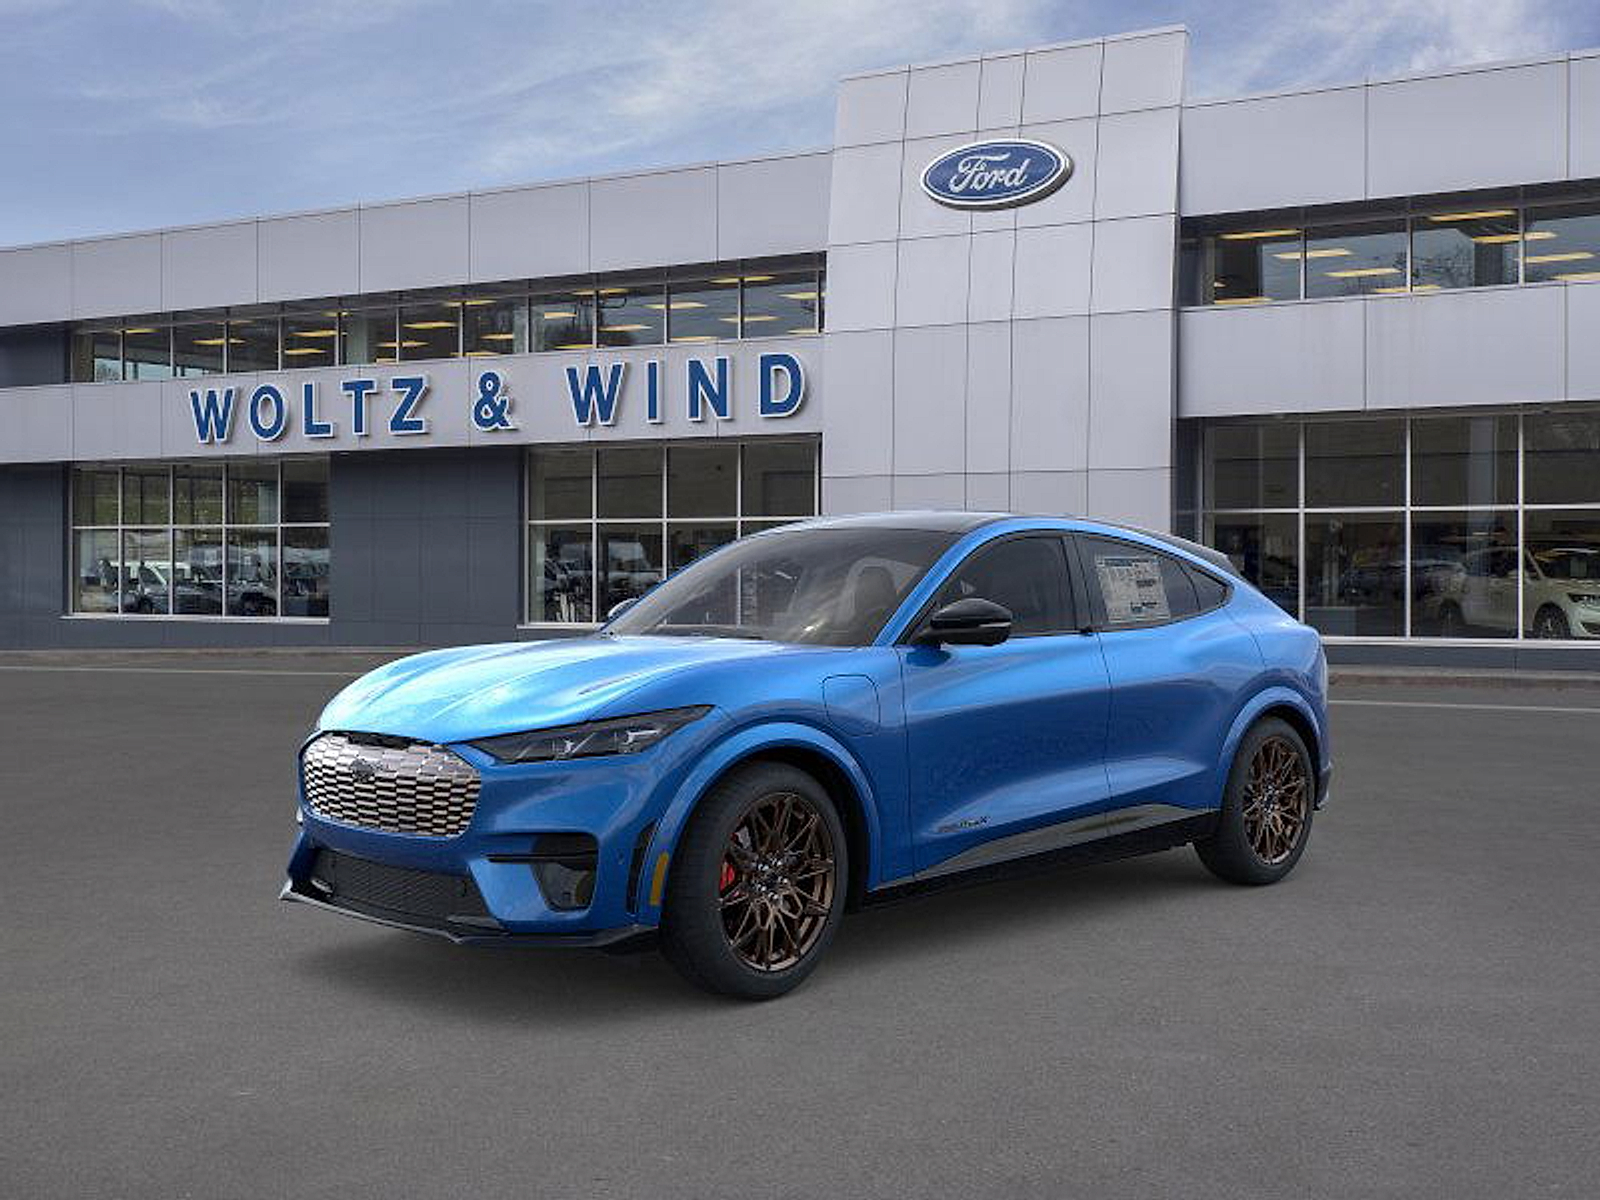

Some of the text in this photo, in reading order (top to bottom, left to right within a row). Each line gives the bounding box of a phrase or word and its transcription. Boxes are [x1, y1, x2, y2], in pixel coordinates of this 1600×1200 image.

[950, 152, 1031, 193] Ford
[189, 352, 806, 443] WOLTZ & WIND
